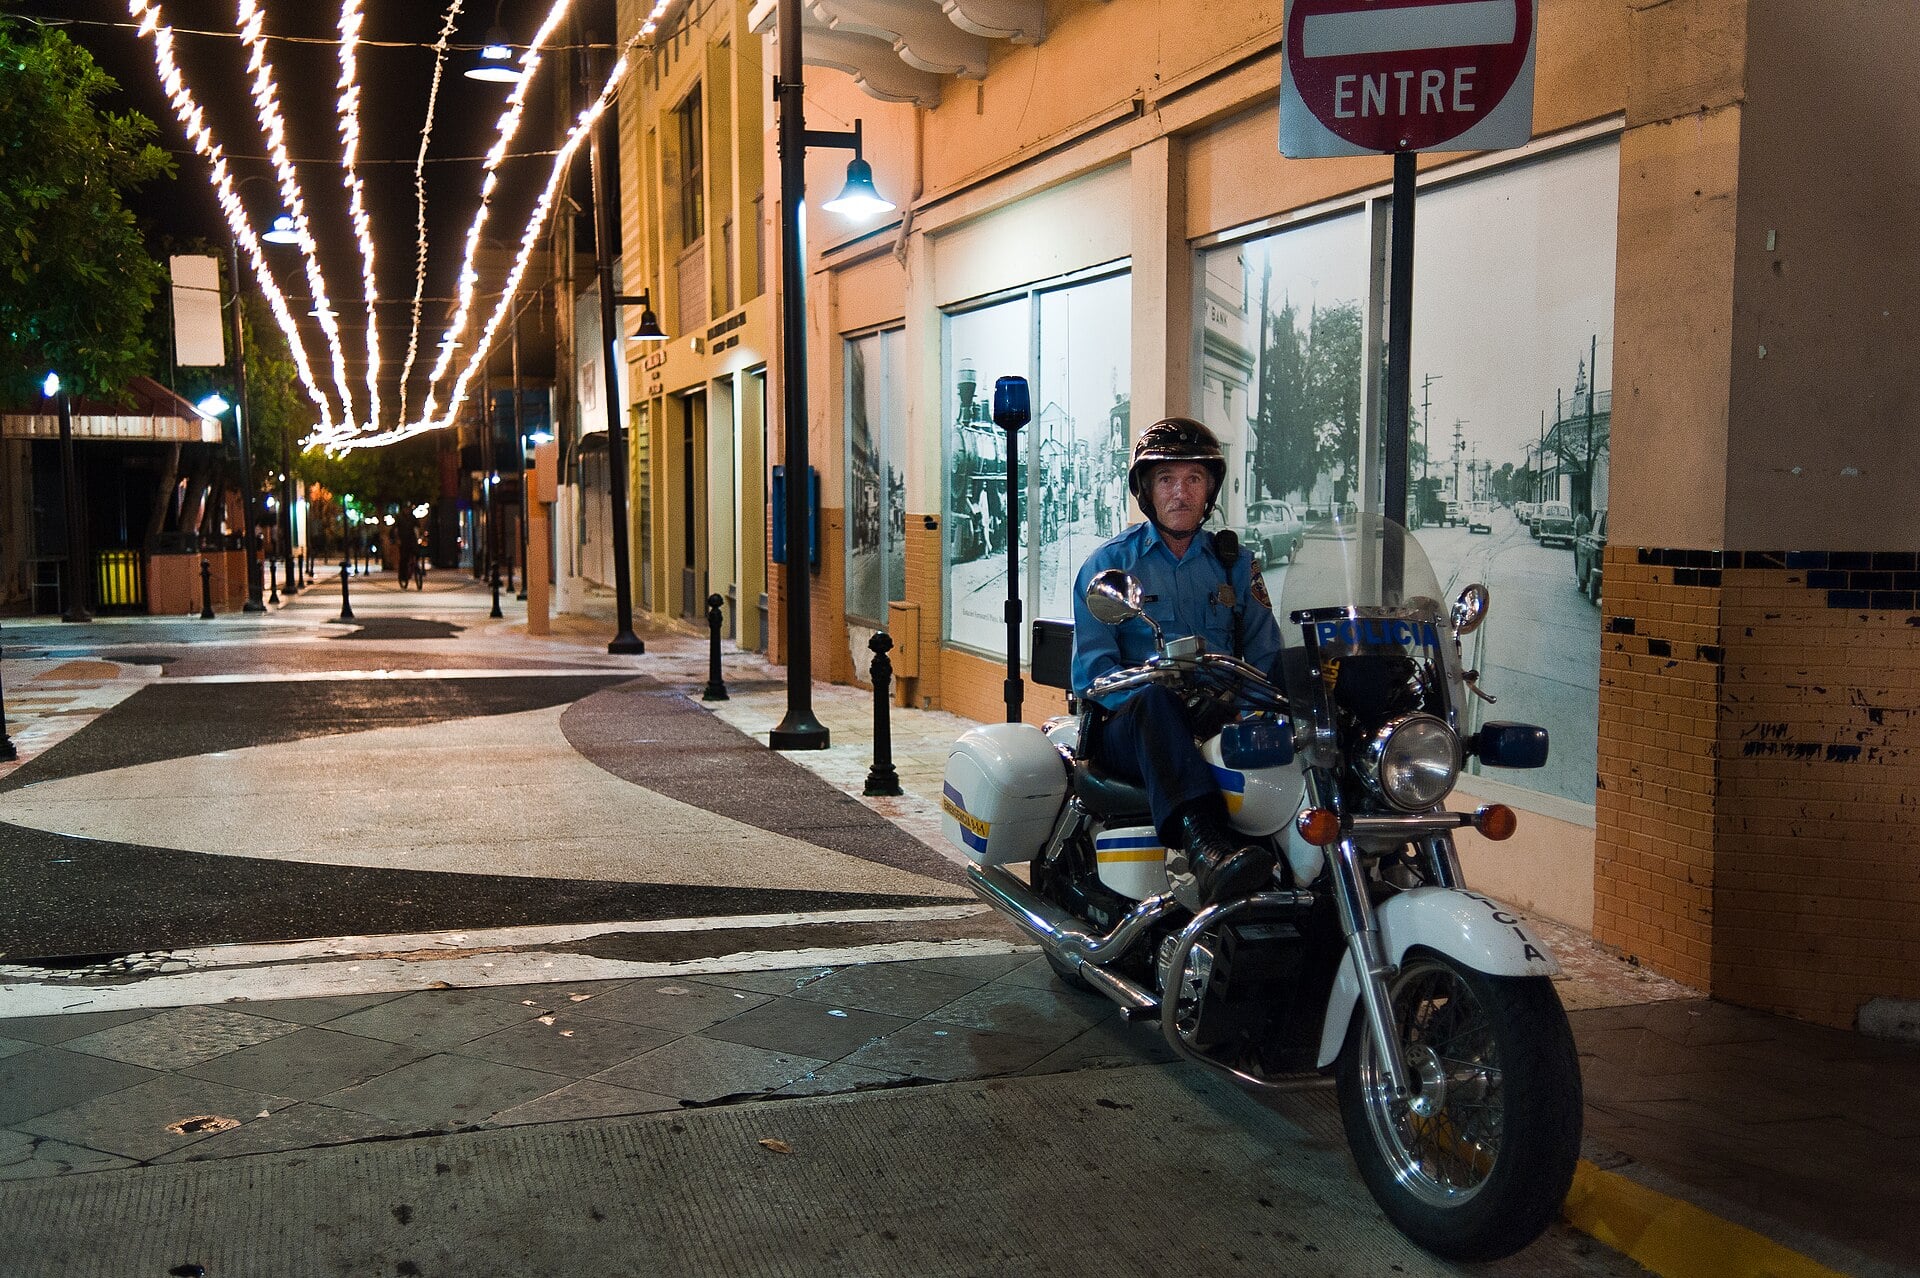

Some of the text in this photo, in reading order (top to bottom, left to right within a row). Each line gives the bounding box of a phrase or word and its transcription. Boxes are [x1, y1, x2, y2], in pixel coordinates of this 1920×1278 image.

[1334, 66, 1477, 119] ENTRE
[1211, 306, 1229, 326] BANK
[1316, 620, 1439, 649] POLICIA
